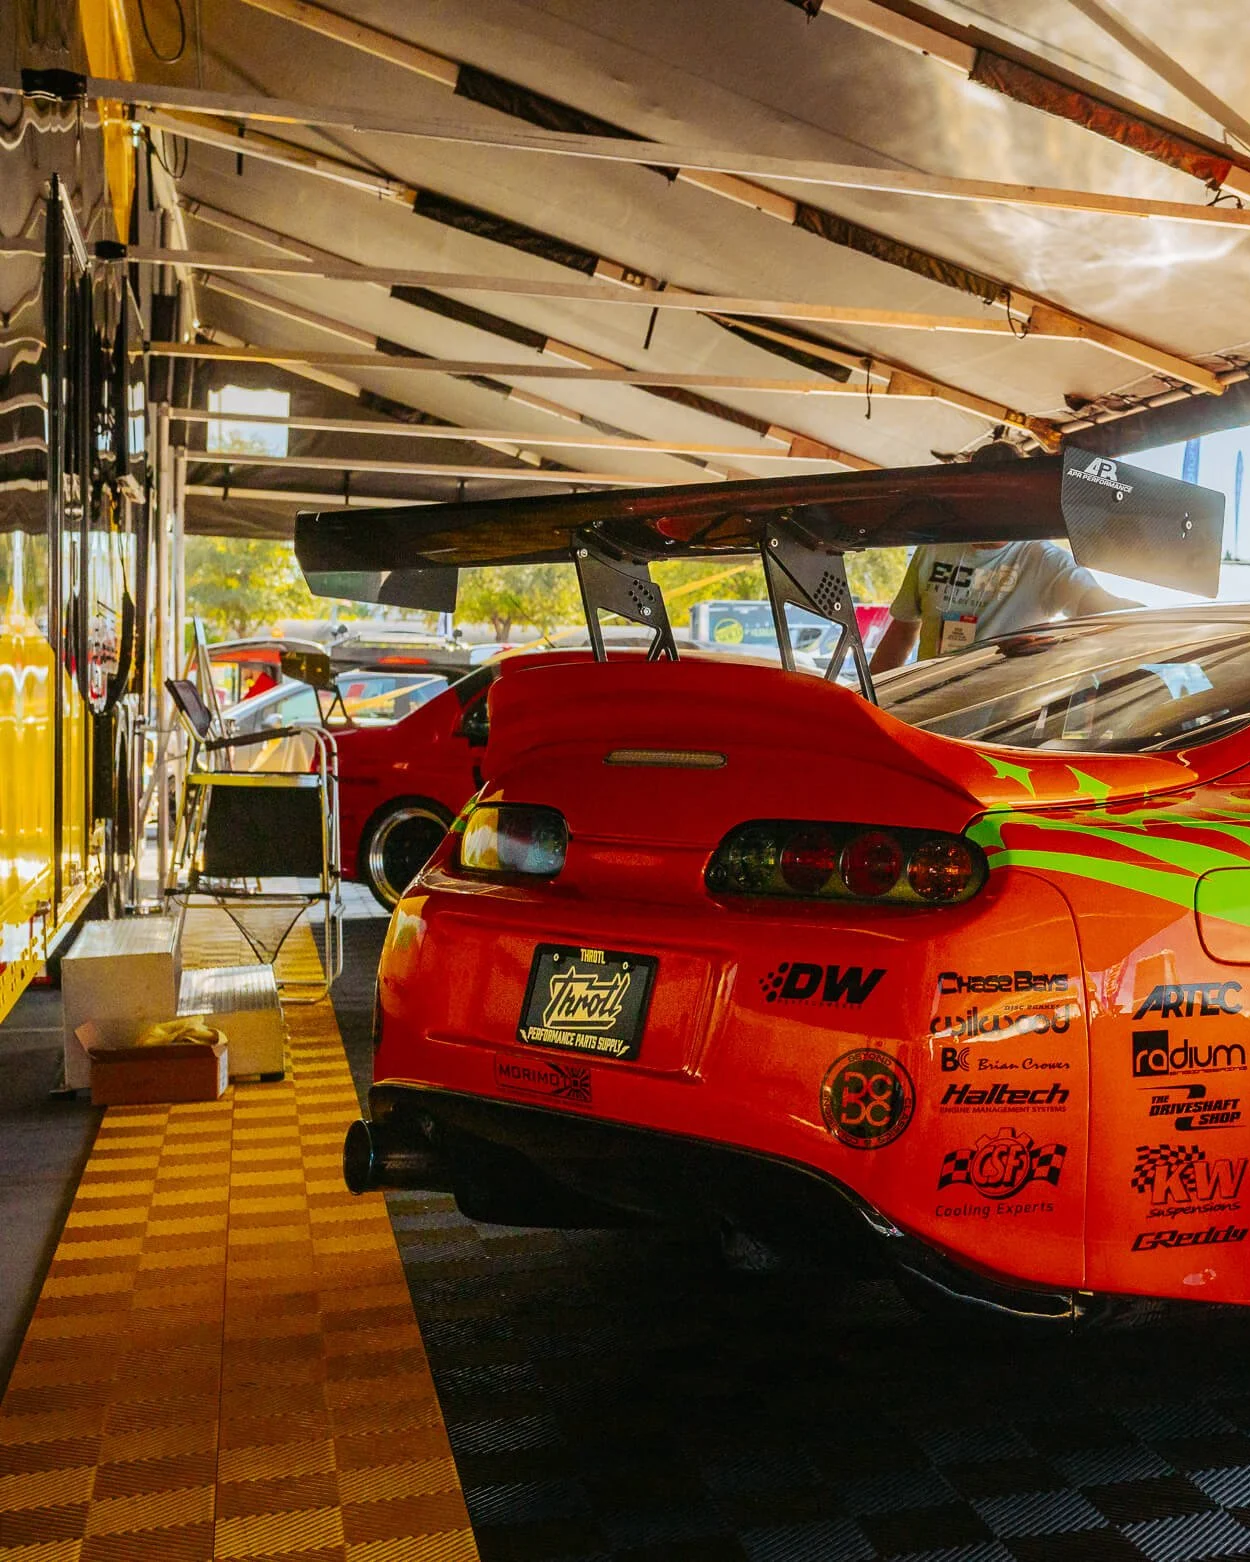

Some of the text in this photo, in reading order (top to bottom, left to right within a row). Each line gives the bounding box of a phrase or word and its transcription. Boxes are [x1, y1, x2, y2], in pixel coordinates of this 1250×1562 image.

[580, 948, 606, 965] THROTL
[780, 962, 887, 1004] DW
[1132, 981, 1243, 1020] ARTEC
[528, 1027, 623, 1053] PERFORMANCE PARTS SUPPLY
[978, 1058, 1019, 1071] Brian
[1135, 1039, 1246, 1073] radium
[940, 1083, 1070, 1105] Haltech
[1152, 1095, 1169, 1104] THE
[1149, 1099, 1240, 1116] DRIVESHAFT
[1199, 1112, 1241, 1125] SHOP
[973, 1143, 1027, 1188] CSF
[1152, 1158, 1248, 1205] KW
[935, 1202, 1054, 1219] Cooling Experts
